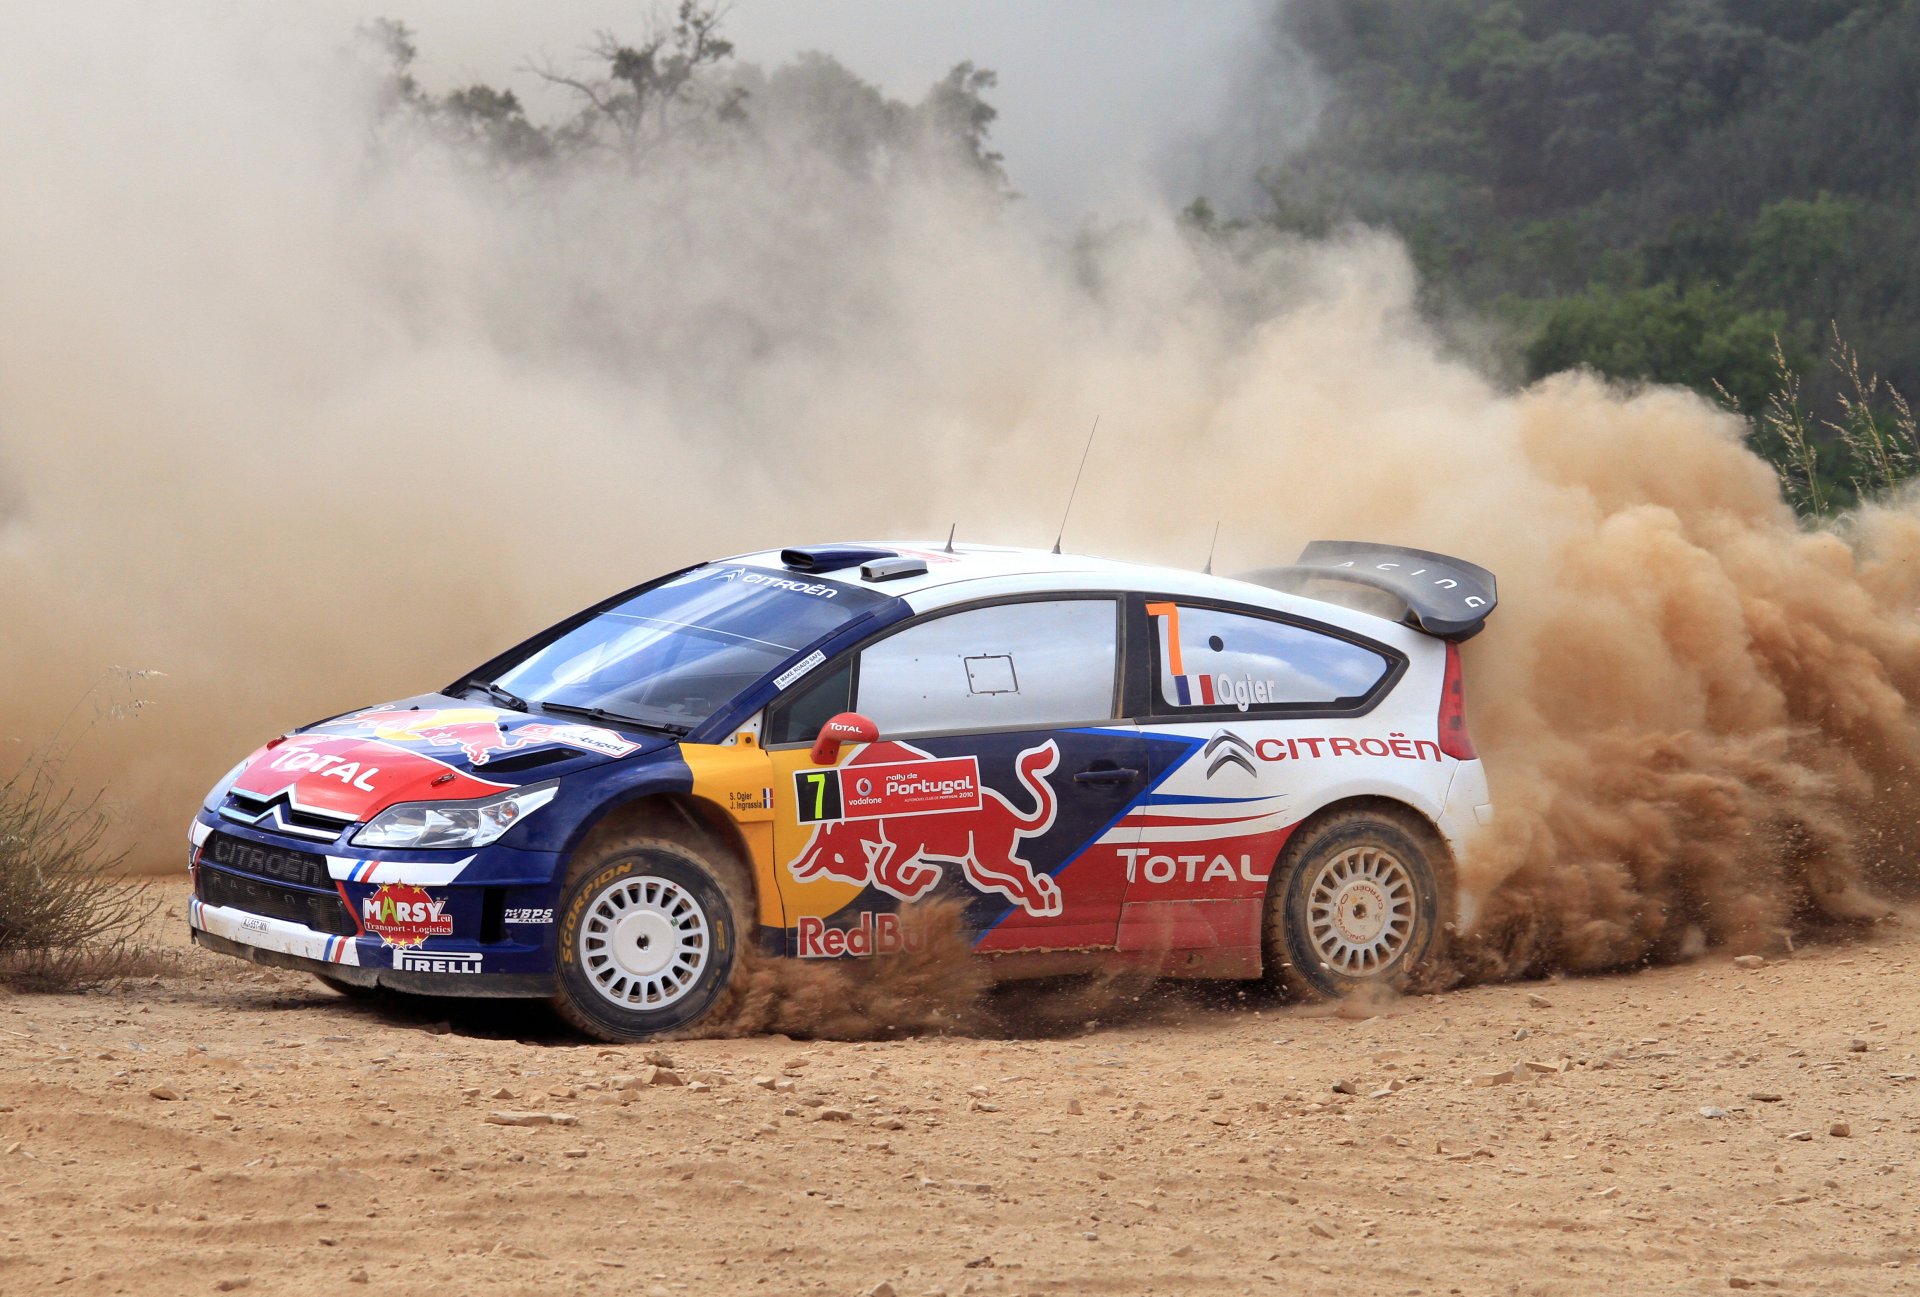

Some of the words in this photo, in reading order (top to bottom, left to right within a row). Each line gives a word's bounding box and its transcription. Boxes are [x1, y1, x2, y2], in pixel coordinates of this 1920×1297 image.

[742, 573, 839, 599] CITROËN
[1145, 602, 1184, 676] 7
[780, 670, 795, 682] MAKE
[793, 661, 810, 673] ROADS
[809, 651, 822, 663] SAFE
[1217, 673, 1275, 712] Ogier
[830, 722, 863, 734] TOTAL
[1255, 732, 1442, 762] CITROËN
[270, 746, 379, 792] TOTAL
[730, 792, 736, 800] S.
[737, 791, 752, 802] Ogier
[807, 773, 826, 819] 7
[886, 776, 974, 796] Portugal
[730, 801, 736, 810] J.
[737, 800, 762, 811] Ingrassia
[848, 797, 882, 806] vodafone
[215, 839, 320, 884] CITROËN
[1116, 848, 1268, 883] TOTAL
[520, 908, 554, 918] BPS
[562, 862, 634, 963] SCORPION
[366, 922, 405, 932] Transport
[413, 925, 451, 934] Logistics
[797, 911, 873, 958] Red
[876, 913, 930, 956] Bu
[393, 950, 483, 974] PIRELLI
